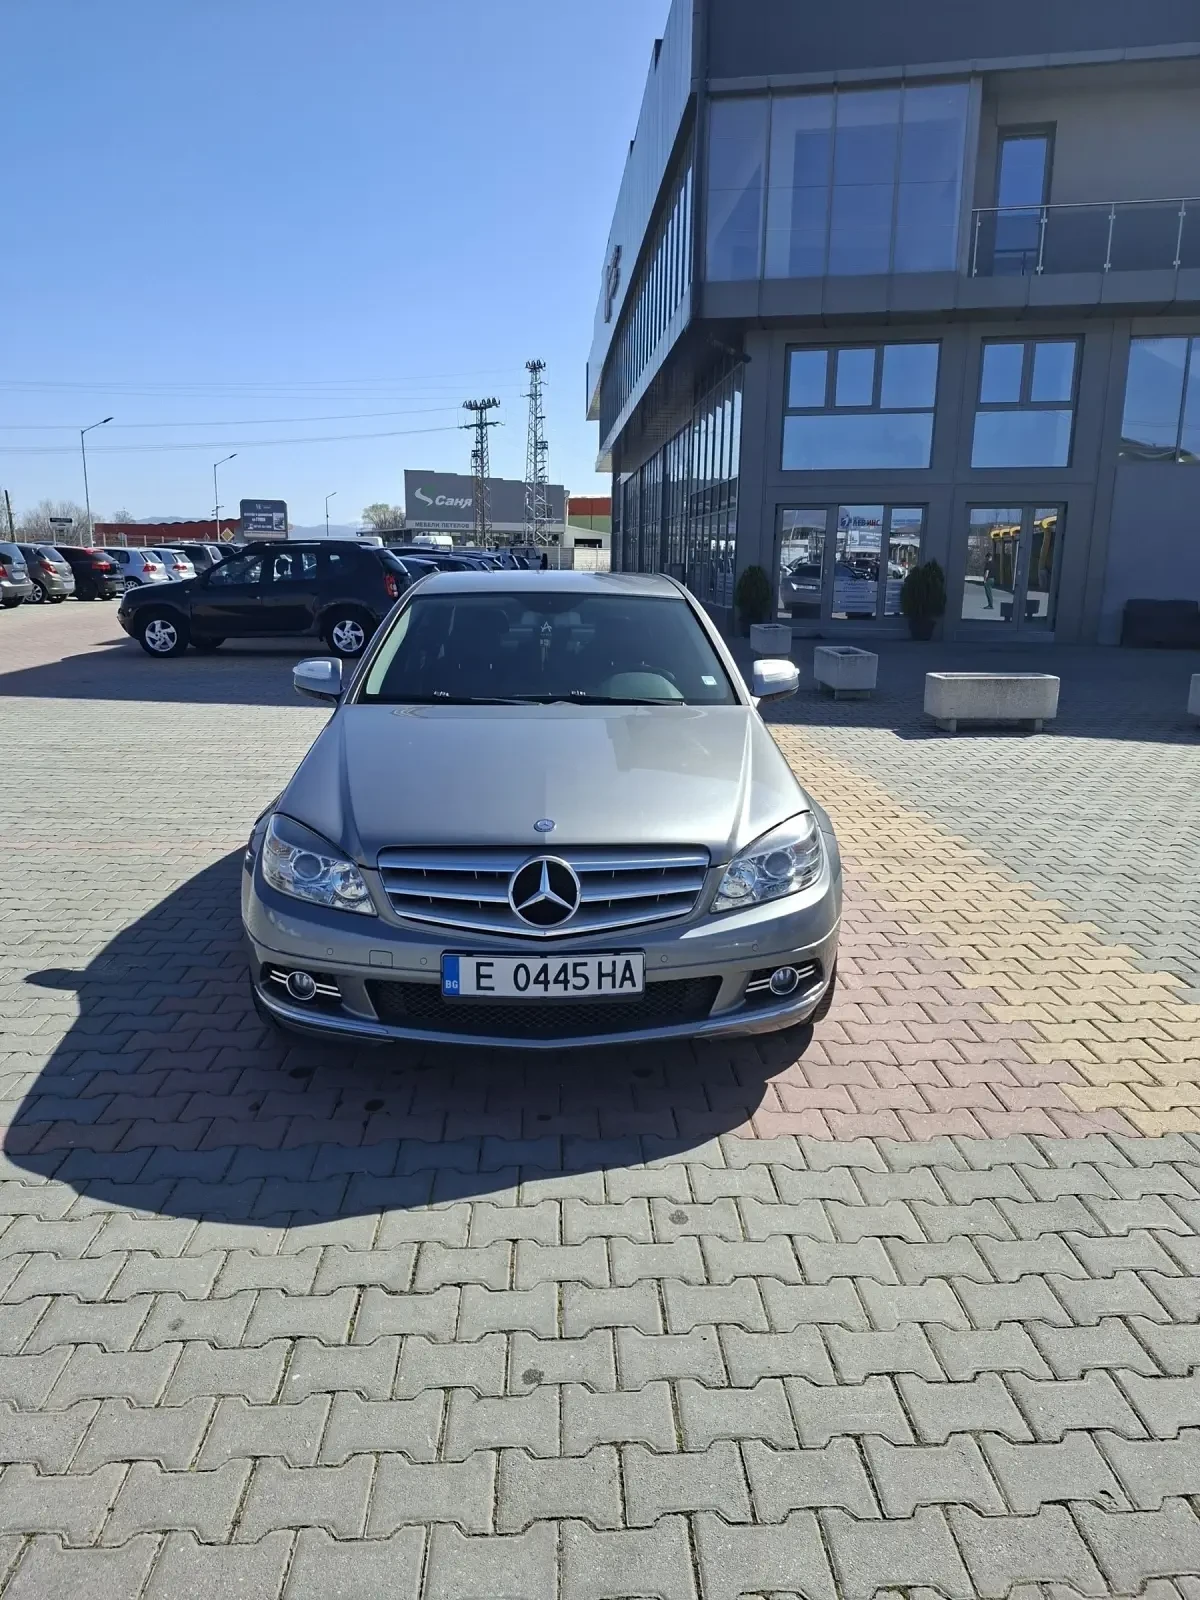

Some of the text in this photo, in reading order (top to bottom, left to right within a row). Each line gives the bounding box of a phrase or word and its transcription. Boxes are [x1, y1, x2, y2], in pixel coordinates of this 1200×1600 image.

[435, 495, 473, 509] Саня
[475, 960, 636, 992] E 0445 HA
[445, 980, 459, 989] BG
